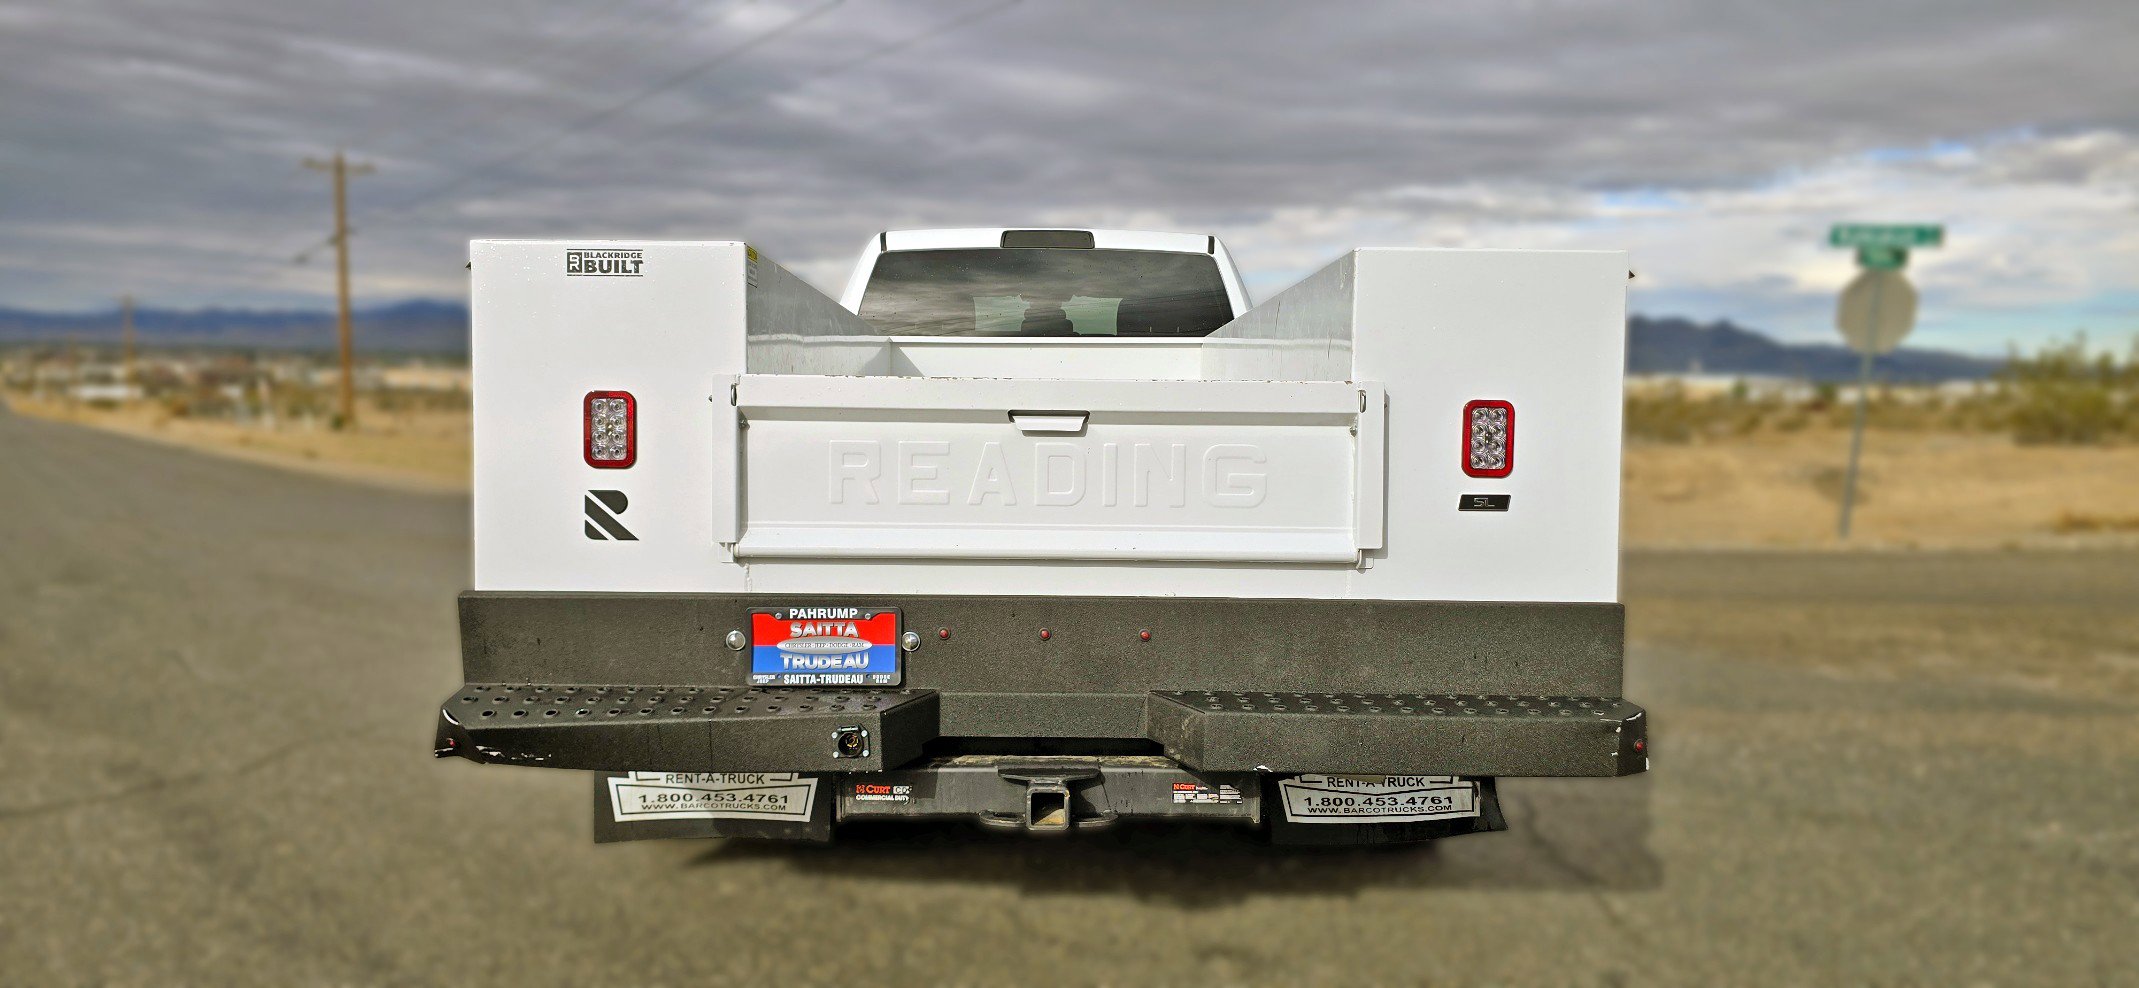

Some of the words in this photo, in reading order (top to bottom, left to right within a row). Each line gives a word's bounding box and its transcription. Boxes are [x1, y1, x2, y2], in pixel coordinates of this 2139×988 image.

[584, 259, 644, 274] BUILT
[828, 440, 1268, 509] READING
[789, 608, 859, 619] PAHRUMP
[789, 621, 860, 638] SAITTA
[779, 652, 870, 671] TRUDEAU
[783, 674, 864, 685] SAITTA-TRUDEAU
[665, 773, 765, 784] RENT-A-TRUCK
[1327, 776, 1426, 788] RENT-TRUCK
[638, 793, 789, 804] 1.800.453.4761
[1304, 796, 1453, 807] 1.800.453.4761
[641, 803, 787, 812] WWW.BARCOTRUCKS.COM
[1307, 804, 1453, 815] WWW.BARCOTRUCKS.COM
